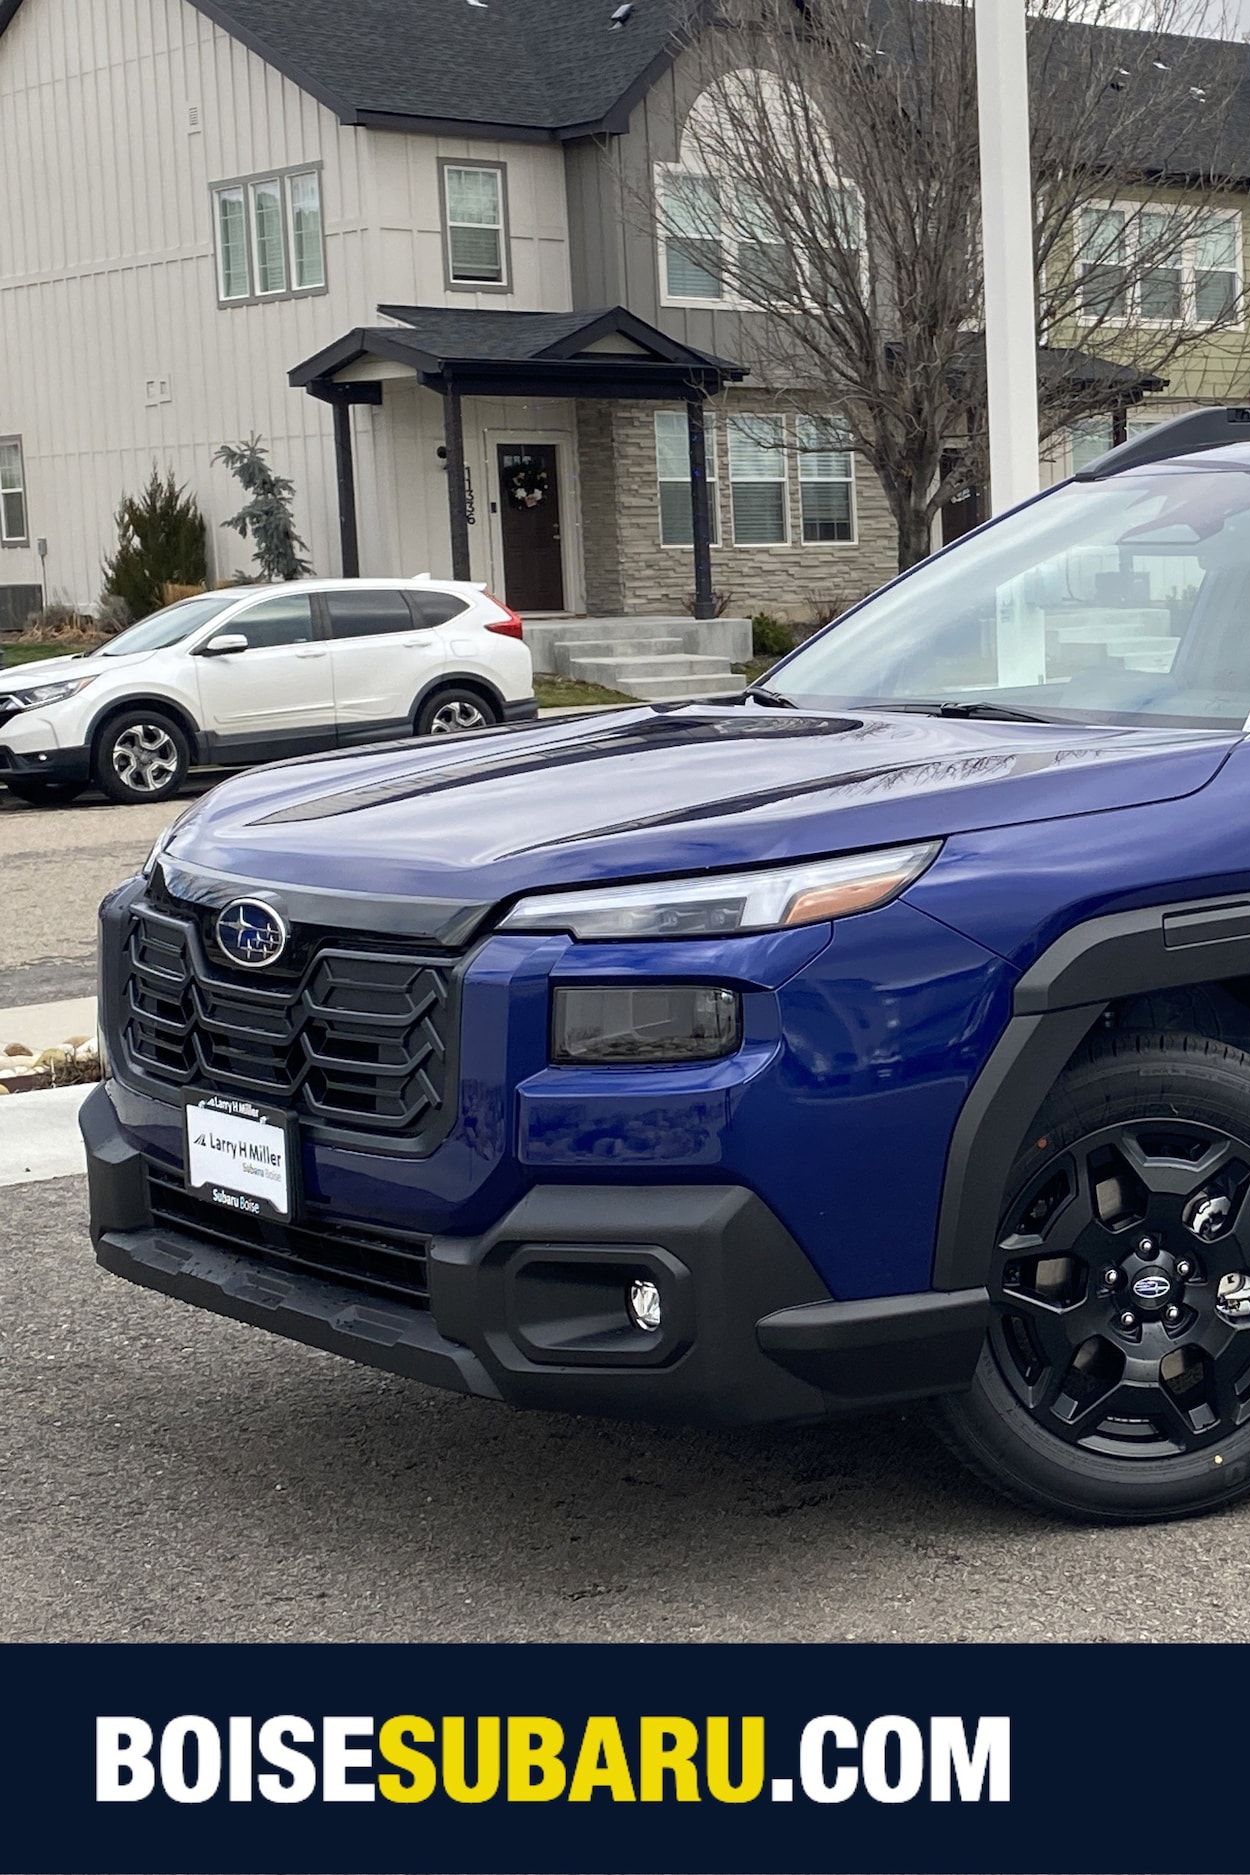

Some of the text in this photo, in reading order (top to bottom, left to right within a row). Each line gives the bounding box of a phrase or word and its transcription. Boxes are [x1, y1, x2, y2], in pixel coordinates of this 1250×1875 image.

[465, 466, 476, 525] 11336
[214, 1096, 260, 1118] Larry H Miller
[209, 1132, 282, 1167] Larry H Miller
[242, 1162, 265, 1178] Subaru
[212, 1188, 260, 1214] Subaru Boise
